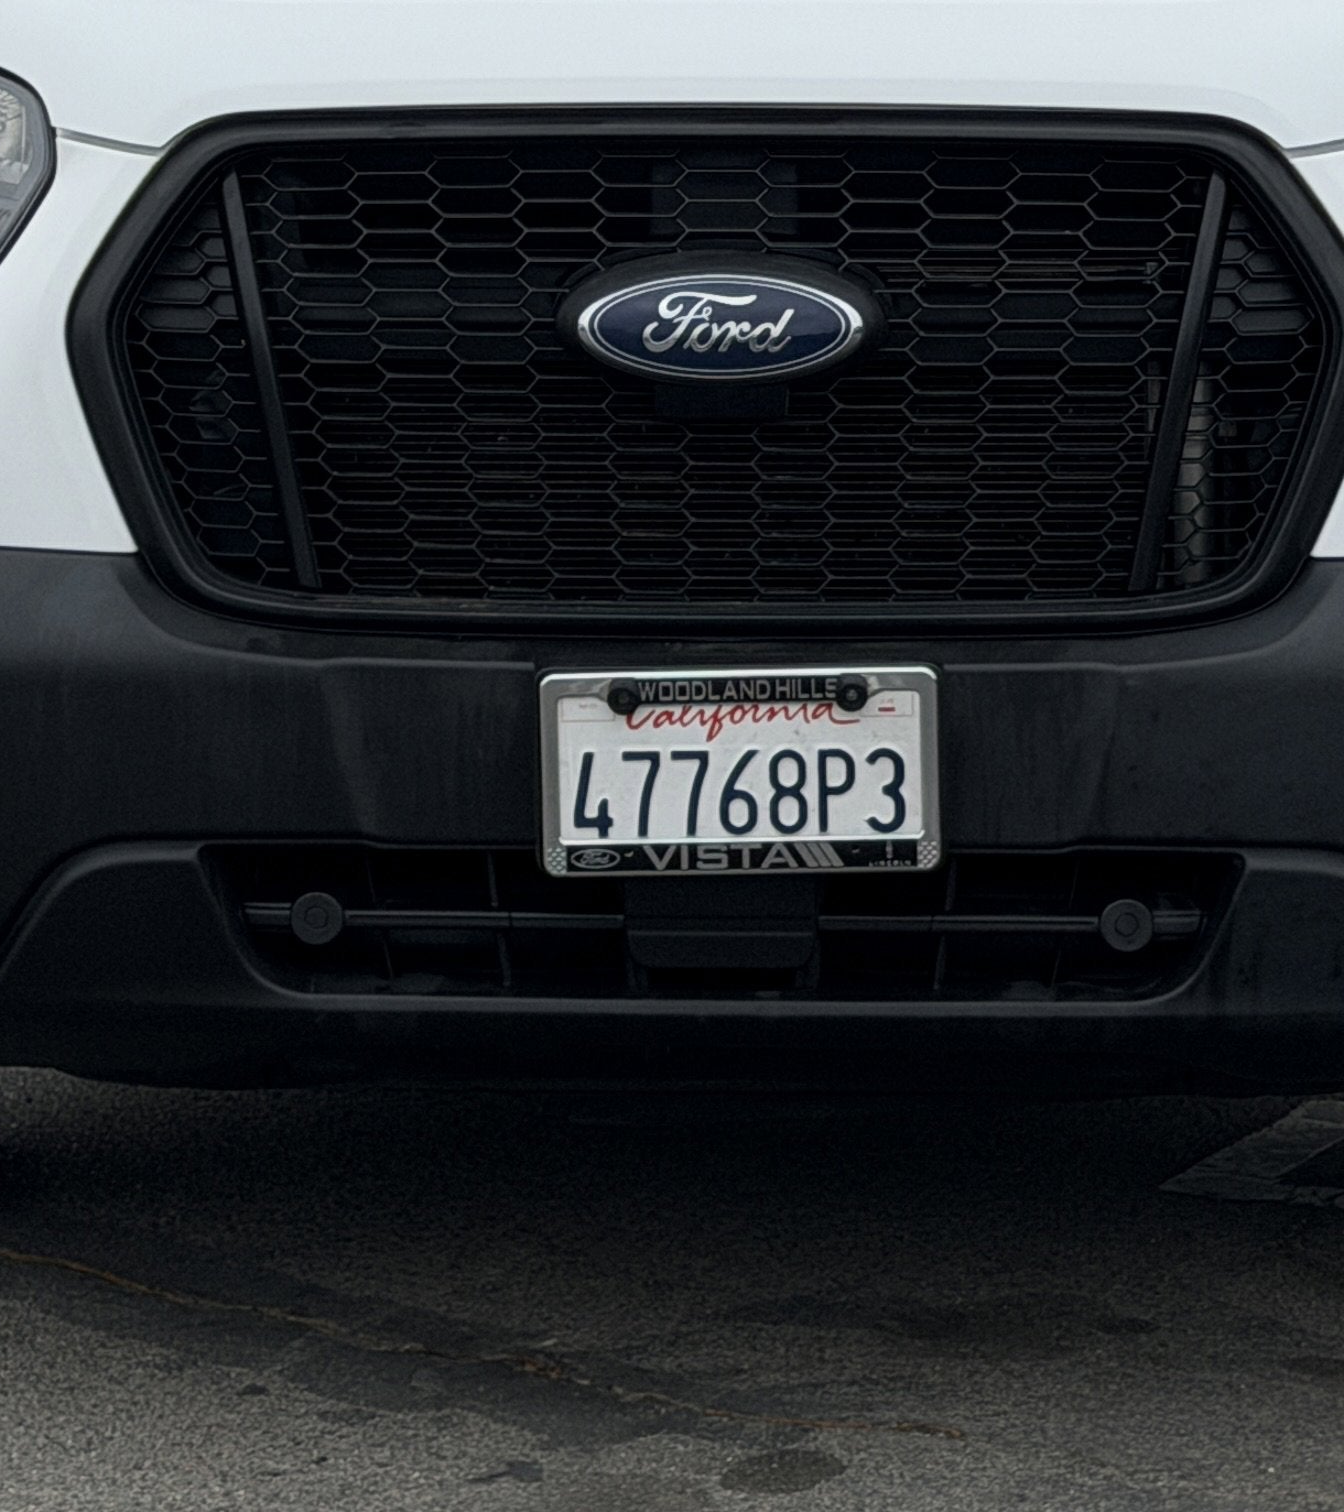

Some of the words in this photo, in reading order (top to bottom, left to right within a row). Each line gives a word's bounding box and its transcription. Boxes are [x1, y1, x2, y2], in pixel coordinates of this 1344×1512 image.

[642, 291, 795, 353] Ford
[637, 679, 771, 702] WOODLAND
[775, 677, 838, 700] HILLS
[573, 747, 908, 838] 47768P3
[642, 843, 802, 870] VISTA
